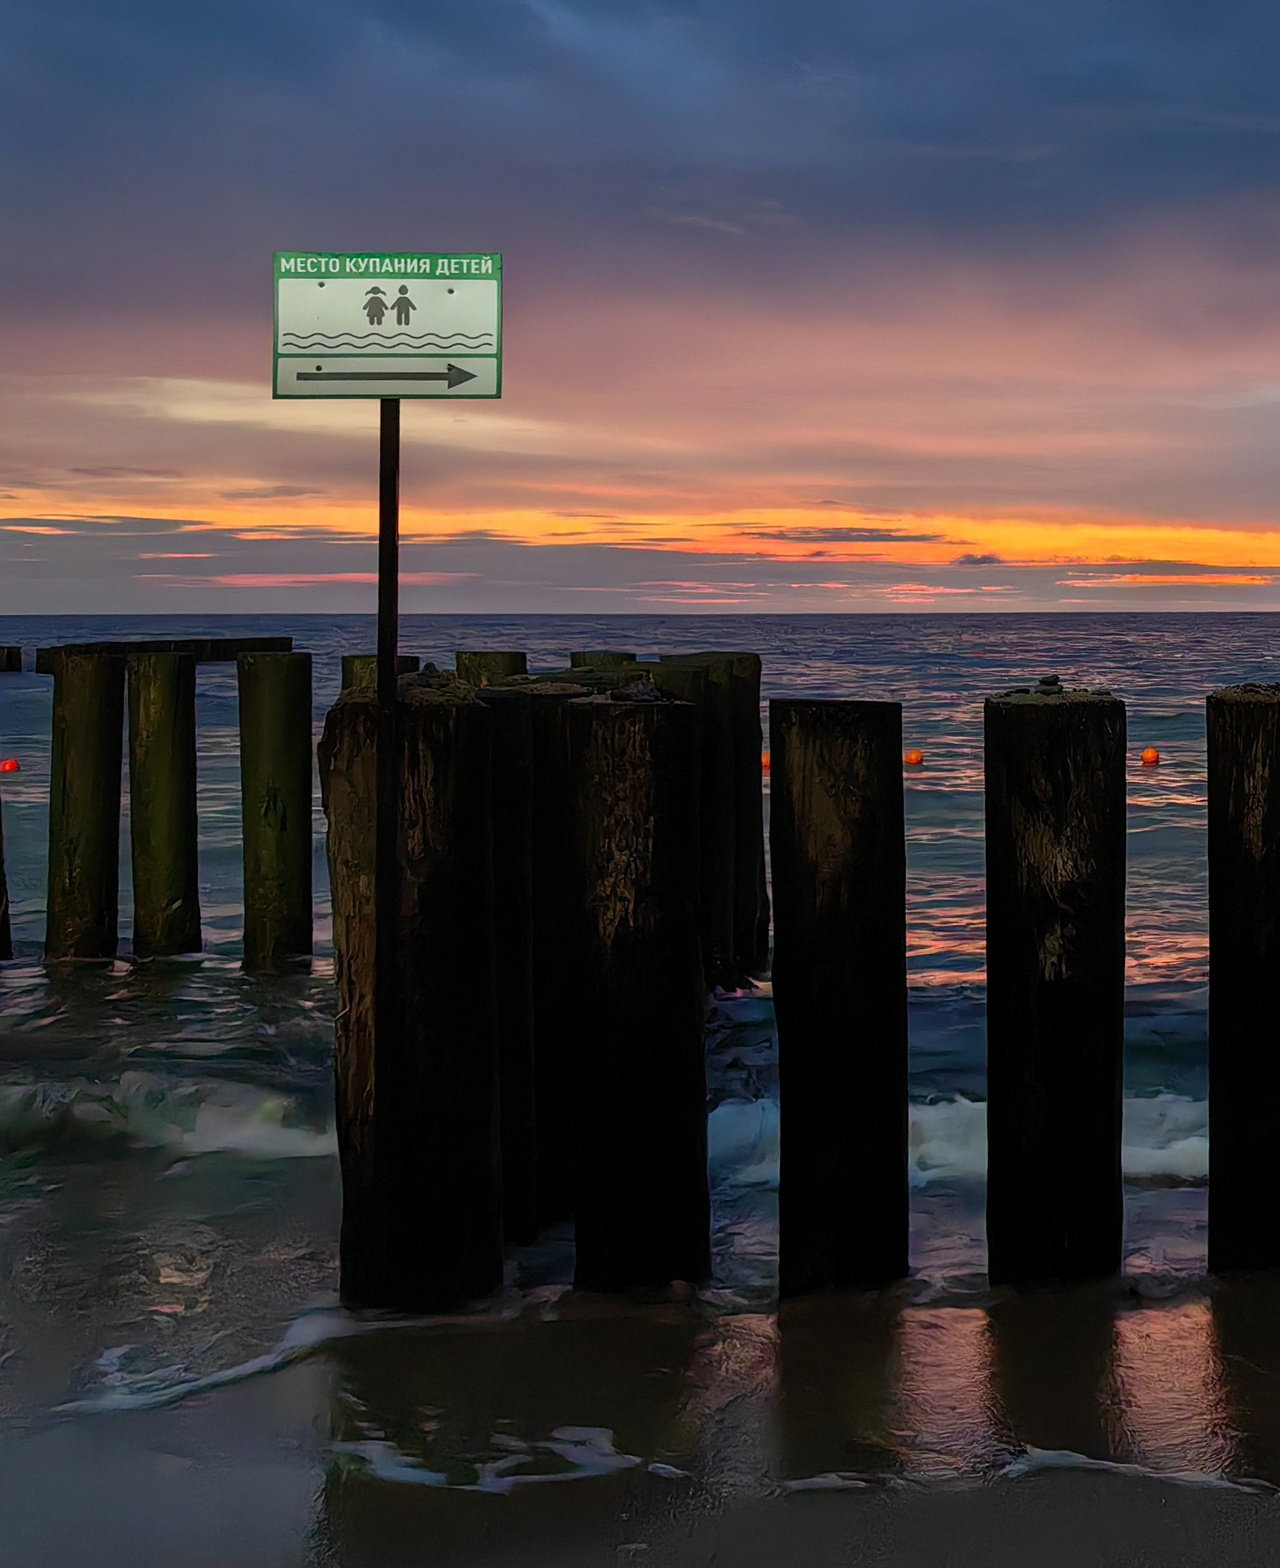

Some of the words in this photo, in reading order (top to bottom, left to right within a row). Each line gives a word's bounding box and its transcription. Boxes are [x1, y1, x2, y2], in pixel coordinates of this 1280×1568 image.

[281, 258, 340, 273] МЕСТО
[346, 257, 430, 274] КУПАНИЯ
[436, 257, 493, 275] ДЕТЕЙ
